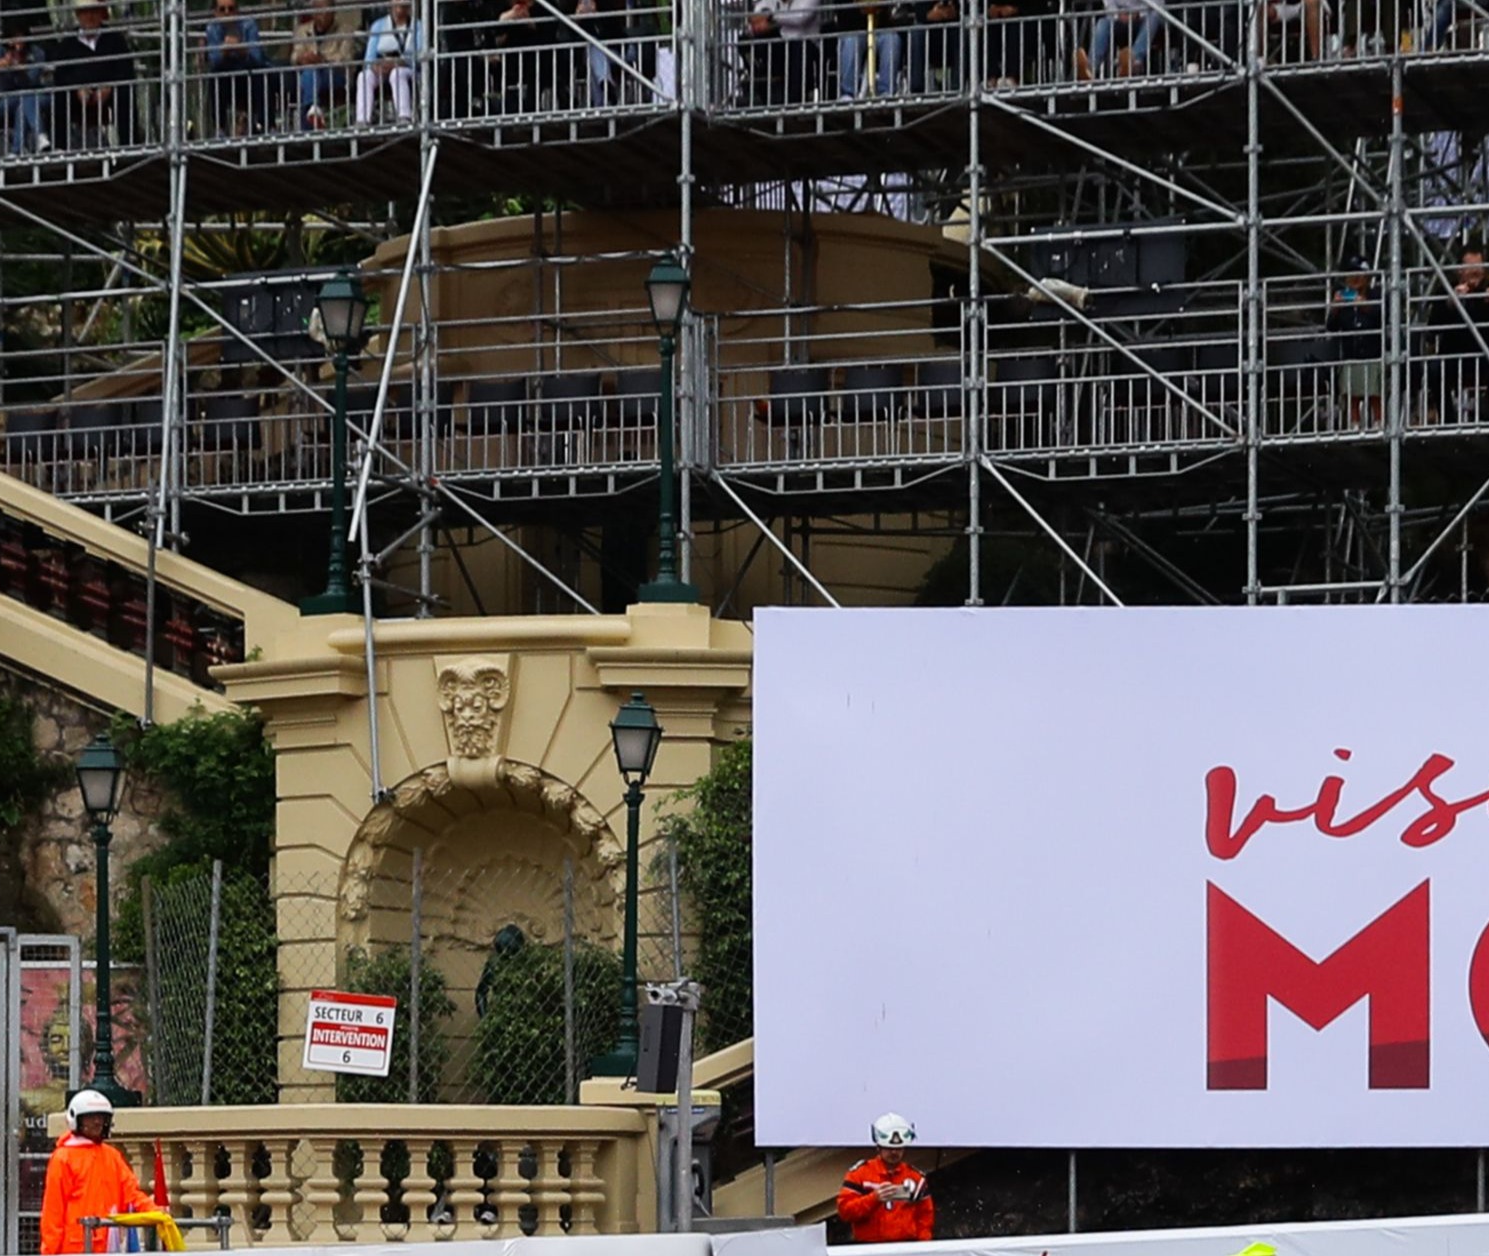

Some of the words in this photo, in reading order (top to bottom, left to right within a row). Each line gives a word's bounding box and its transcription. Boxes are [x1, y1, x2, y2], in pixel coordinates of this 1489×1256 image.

[314, 1005, 363, 1023] SECTEUR
[375, 1011, 385, 1025] 6
[312, 1027, 387, 1049] INTERVENTION
[342, 1049, 352, 1064] 6
